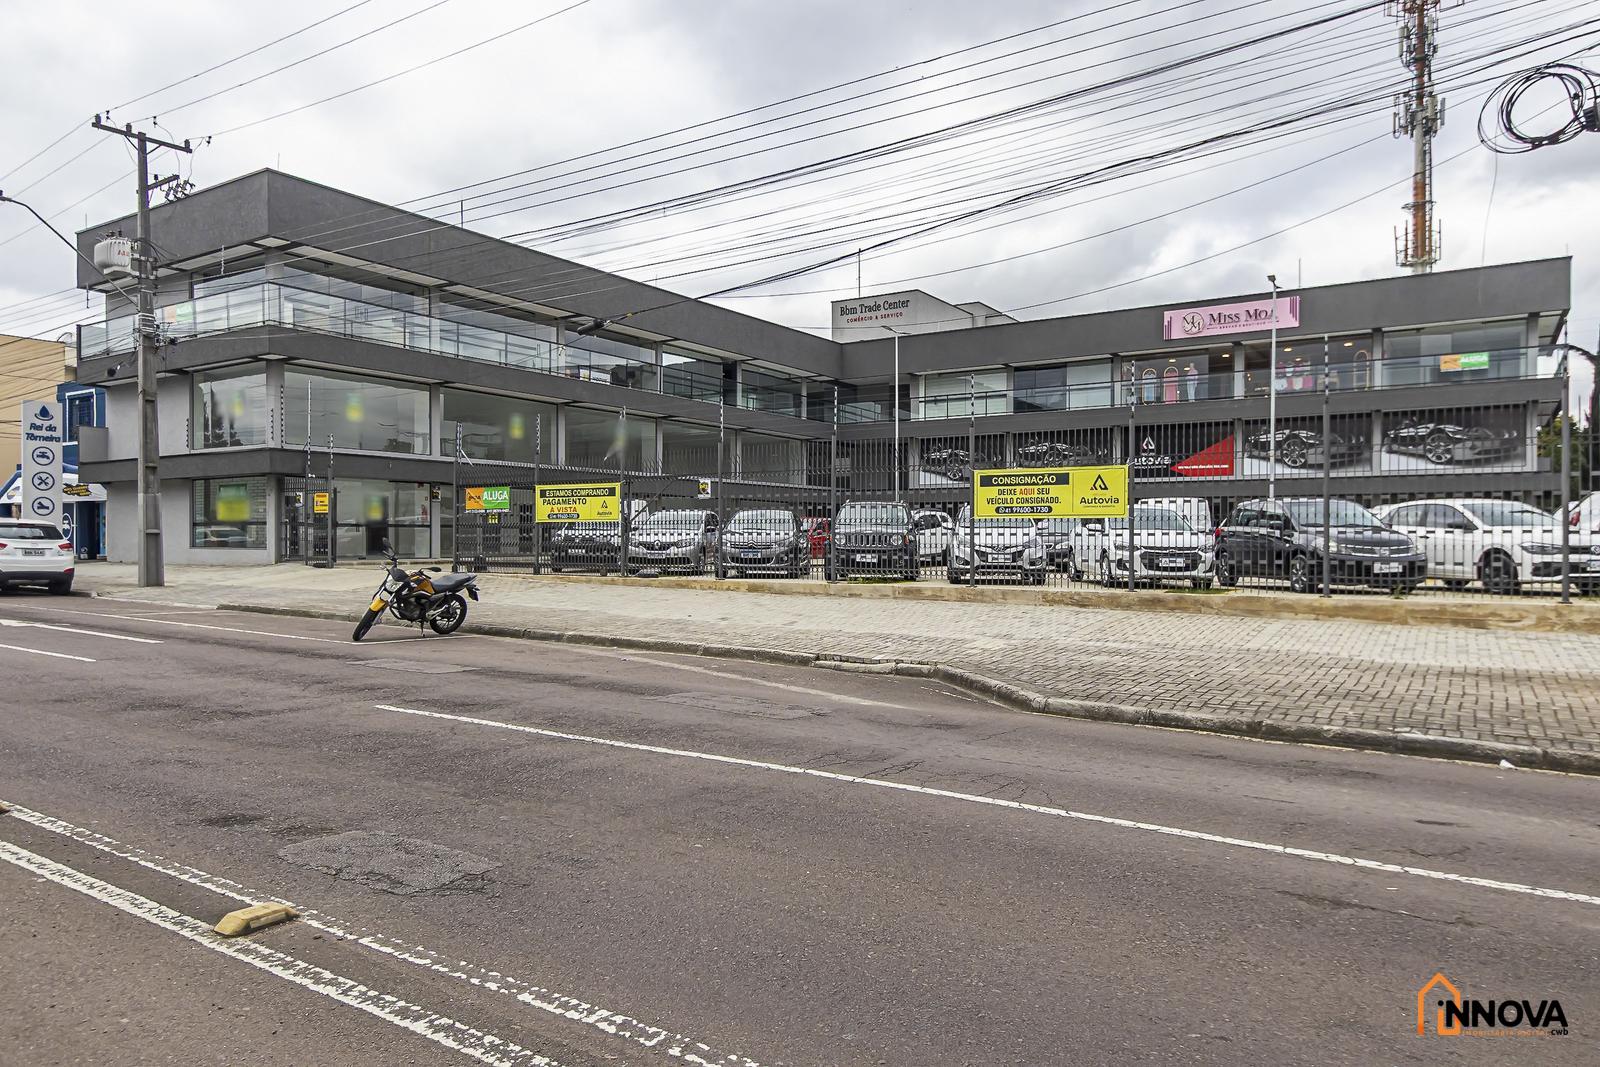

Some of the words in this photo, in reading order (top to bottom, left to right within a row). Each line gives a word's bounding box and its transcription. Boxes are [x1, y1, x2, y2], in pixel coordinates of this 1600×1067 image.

[840, 305, 858, 316] Bbm
[859, 301, 881, 313] Trade
[883, 300, 910, 311] Center
[29, 422, 44, 431] Rei
[45, 423, 57, 432] da
[1127, 455, 1171, 466] utovia
[992, 474, 1057, 485] CONSIGNAÇÃO
[483, 490, 509, 500] ALUGA
[545, 489, 572, 497] ESTAMOS
[572, 488, 609, 496] COMPRANDO
[997, 488, 1017, 496] DEIXE
[1019, 488, 1035, 496] AQUI
[1036, 487, 1050, 495] SEU
[542, 498, 587, 506] PAGAMENTO
[986, 496, 1015, 505] VEÍCULO
[1015, 496, 1062, 504] CONSIGNADO.
[1080, 496, 1120, 505] Autovia
